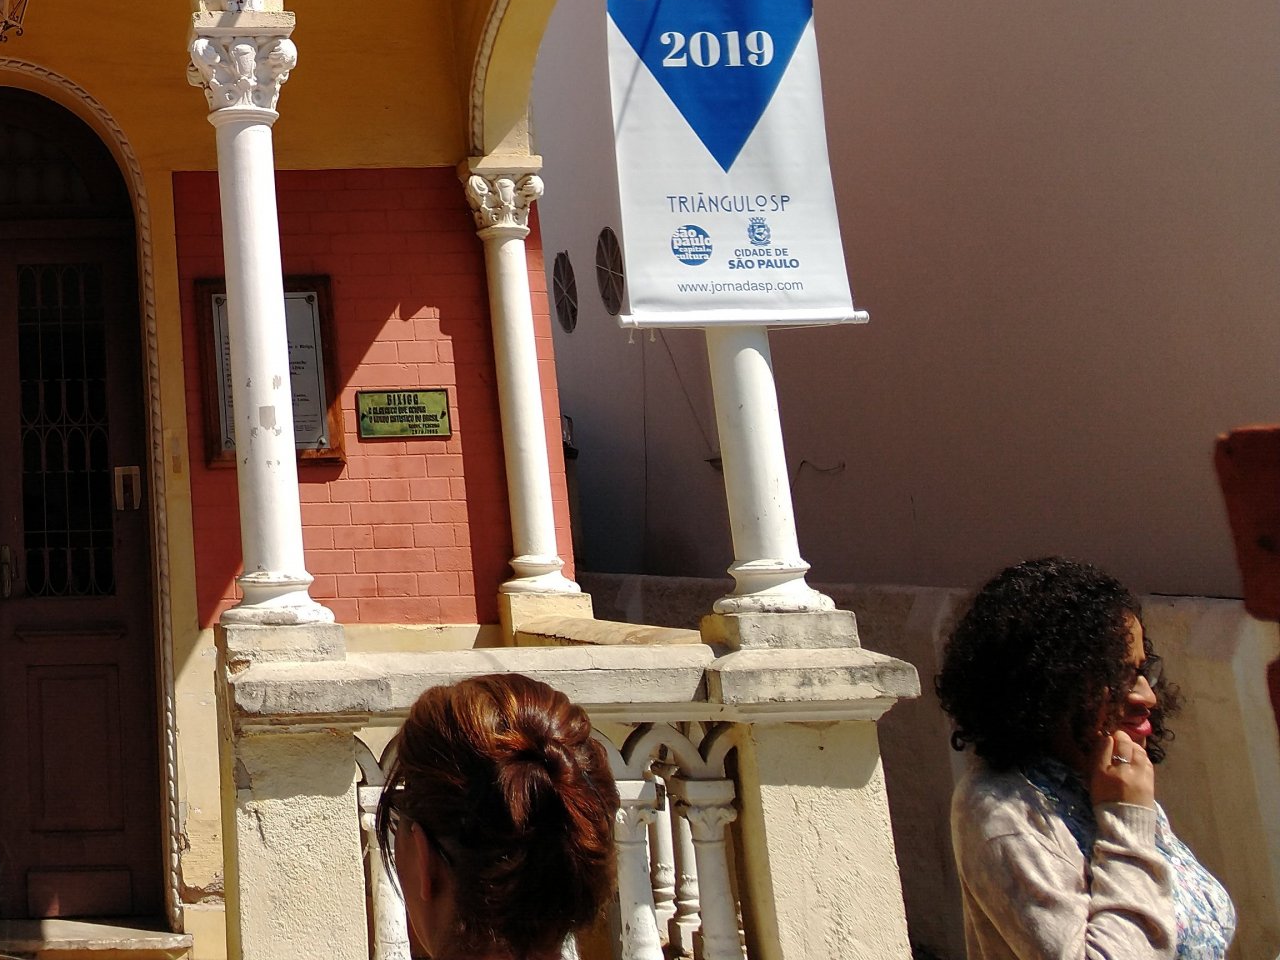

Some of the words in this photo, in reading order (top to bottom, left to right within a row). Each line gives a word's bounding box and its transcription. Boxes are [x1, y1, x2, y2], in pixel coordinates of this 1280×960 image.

[659, 30, 775, 68] 2019
[673, 234, 712, 249] paulo
[734, 248, 772, 257] CIDADE
[774, 248, 789, 256] DE
[728, 257, 755, 269] SÃO
[757, 259, 800, 269] PAULO
[677, 281, 804, 294] www.jornadasp.com
